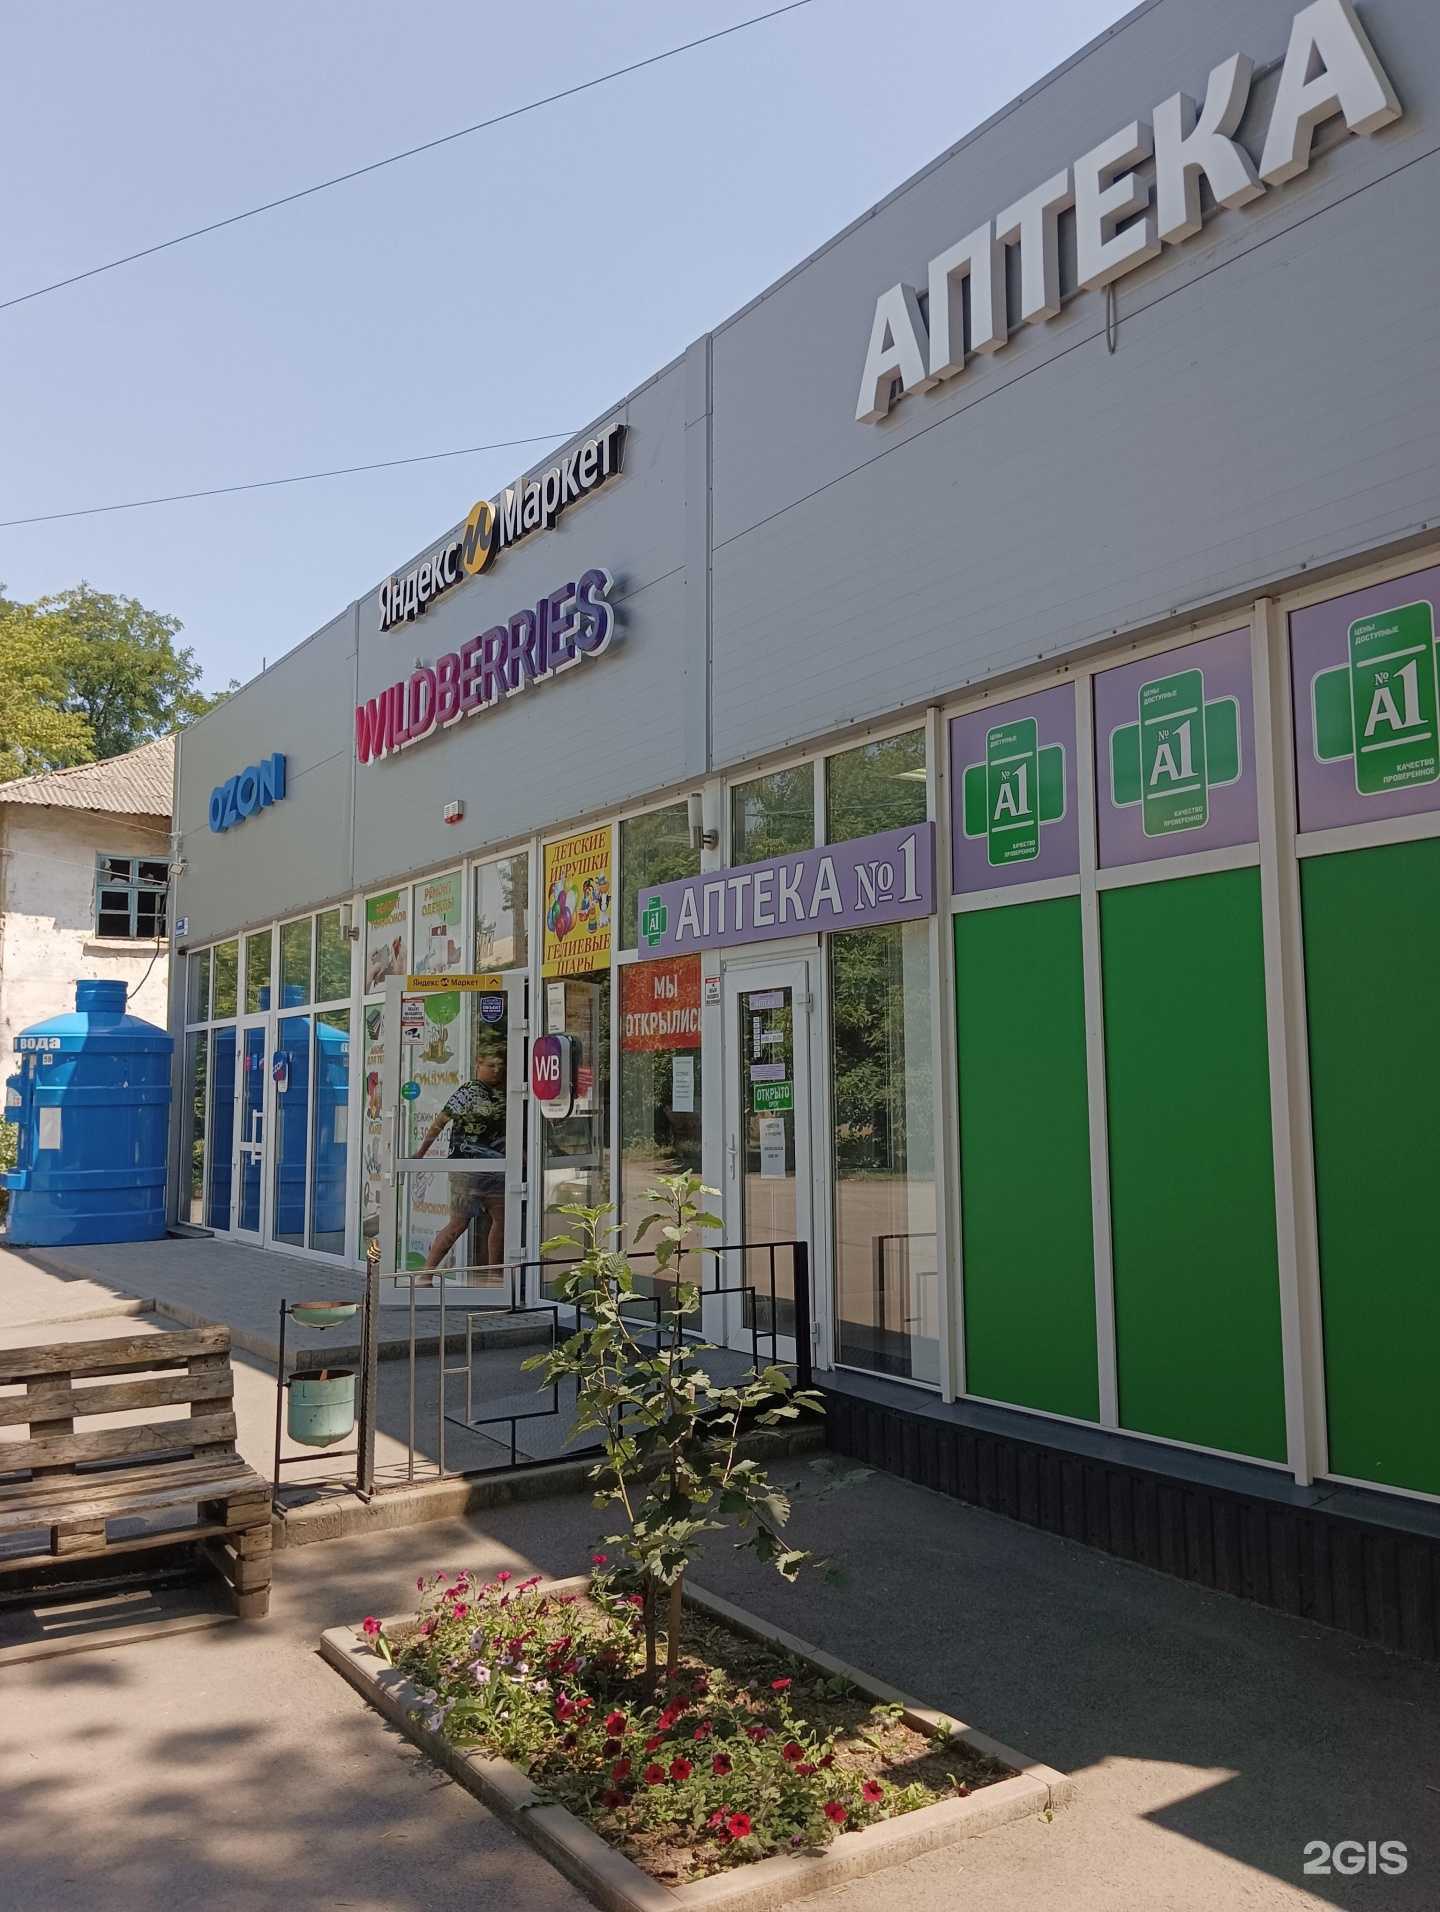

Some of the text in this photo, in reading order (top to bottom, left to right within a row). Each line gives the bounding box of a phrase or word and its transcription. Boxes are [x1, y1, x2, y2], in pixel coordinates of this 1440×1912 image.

[855, 0, 1402, 425] АПТЕКА
[377, 540, 463, 633] Яндекс
[498, 423, 630, 547] Маркет
[355, 567, 614, 765] WILDBERRIES
[208, 752, 286, 833] OZON
[552, 832, 606, 864] ДЕТСКИЕ
[549, 851, 609, 882] ИГРУШКИ
[675, 855, 843, 941] АПТЕКА
[547, 933, 611, 961] ГЕЛИЕВЫЕ
[556, 956, 594, 976] ШАРЫ
[413, 978, 478, 988] Яндекс Маркет
[654, 974, 678, 999] МЫ
[20, 1036, 61, 1051] вода
[535, 1055, 560, 1081] WB
[757, 1087, 789, 1101] ОТКРЫТО
